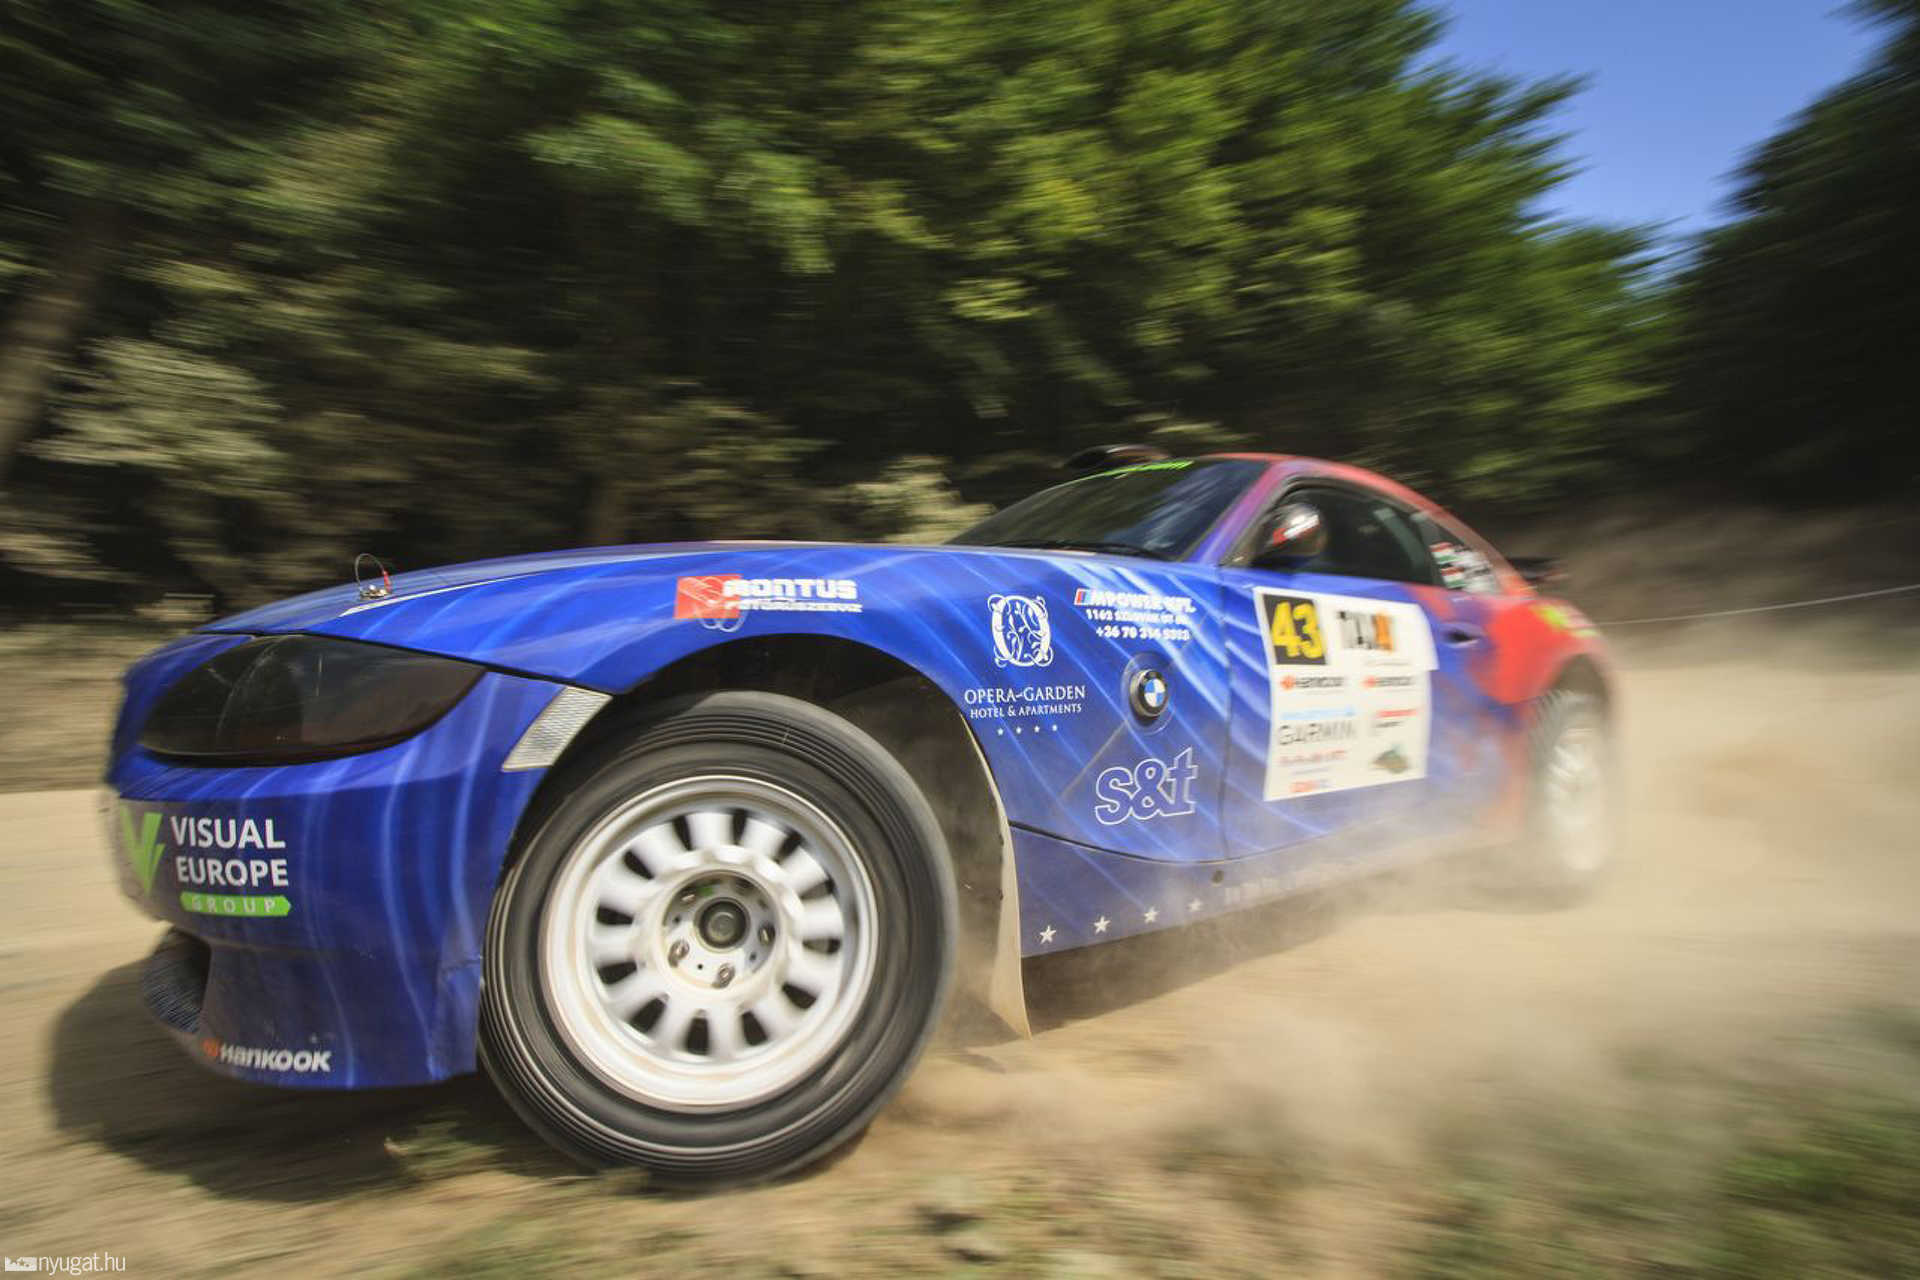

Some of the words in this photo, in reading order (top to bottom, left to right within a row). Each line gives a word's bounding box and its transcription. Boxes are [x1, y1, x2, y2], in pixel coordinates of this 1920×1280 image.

[722, 578, 857, 600] MONTUS
[1096, 625, 1120, 638] +36
[1271, 600, 1323, 660] 43
[970, 706, 1005, 719] HOTEL
[1008, 705, 1017, 717] &
[1019, 703, 1082, 717] APARTMENTS
[170, 815, 287, 850] VISUAL
[175, 856, 289, 887] EUROPE
[191, 896, 277, 914] GROUP
